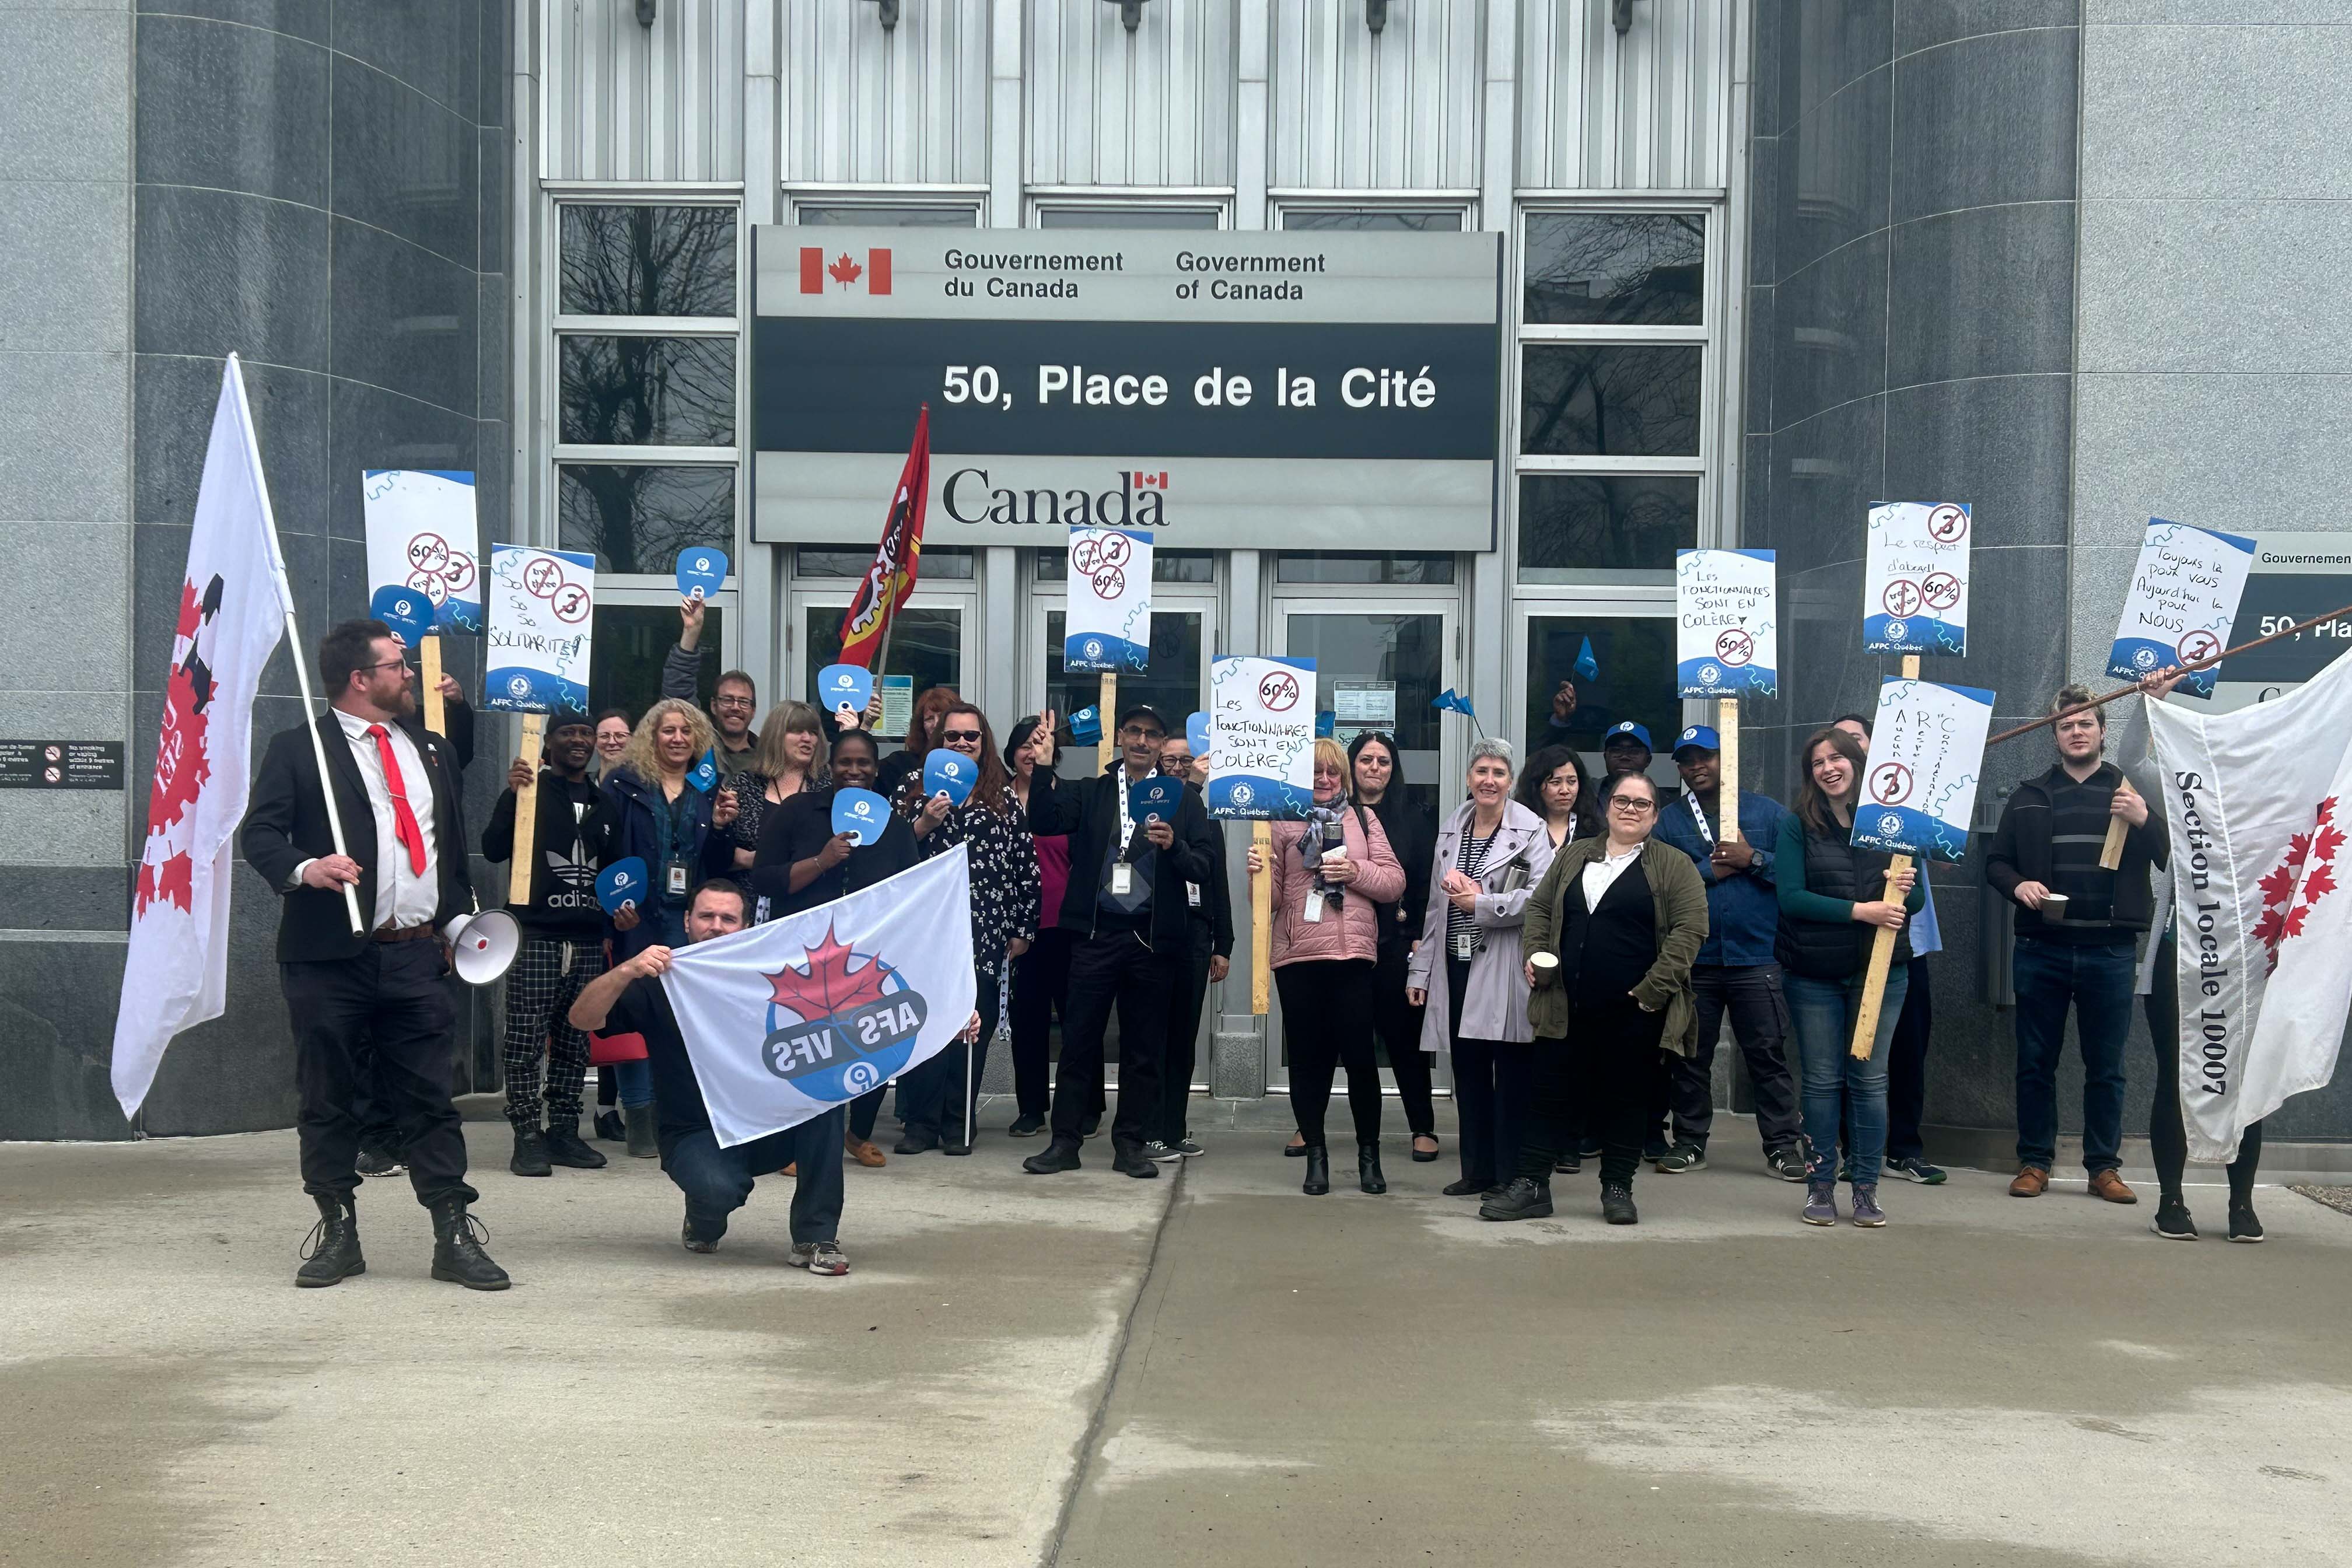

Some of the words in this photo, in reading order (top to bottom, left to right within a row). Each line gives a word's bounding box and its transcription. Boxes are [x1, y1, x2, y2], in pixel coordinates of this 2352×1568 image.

[944, 249, 1124, 272] Gouvernement
[1175, 251, 1325, 273] Government
[944, 277, 974, 298] du
[986, 277, 1079, 299] Canada
[1175, 279, 1200, 300] of
[1210, 279, 1303, 300] Canada
[943, 365, 1013, 411] 50,
[1038, 365, 1168, 406] Place
[1194, 366, 1252, 407] de
[1277, 367, 1317, 407] la
[1340, 366, 1436, 408] Cité
[943, 467, 1170, 527] Canada
[1884, 531, 1907, 548] Le
[2158, 547, 2203, 570] Toujours
[1695, 597, 1729, 610] SONT
[1738, 598, 1756, 609] EN
[2139, 611, 2184, 632] NOUS
[1216, 688, 1242, 711] Les
[1261, 682, 1296, 698] 60%
[1216, 715, 1309, 737] FONCTIONNAIRES
[1228, 735, 1268, 748] SONT
[1276, 740, 1298, 751] EN
[1209, 750, 1281, 770] COLÈRE
[2175, 771, 2211, 893] Section
[2197, 900, 2228, 998] locale
[2200, 1007, 2227, 1096] 10007
